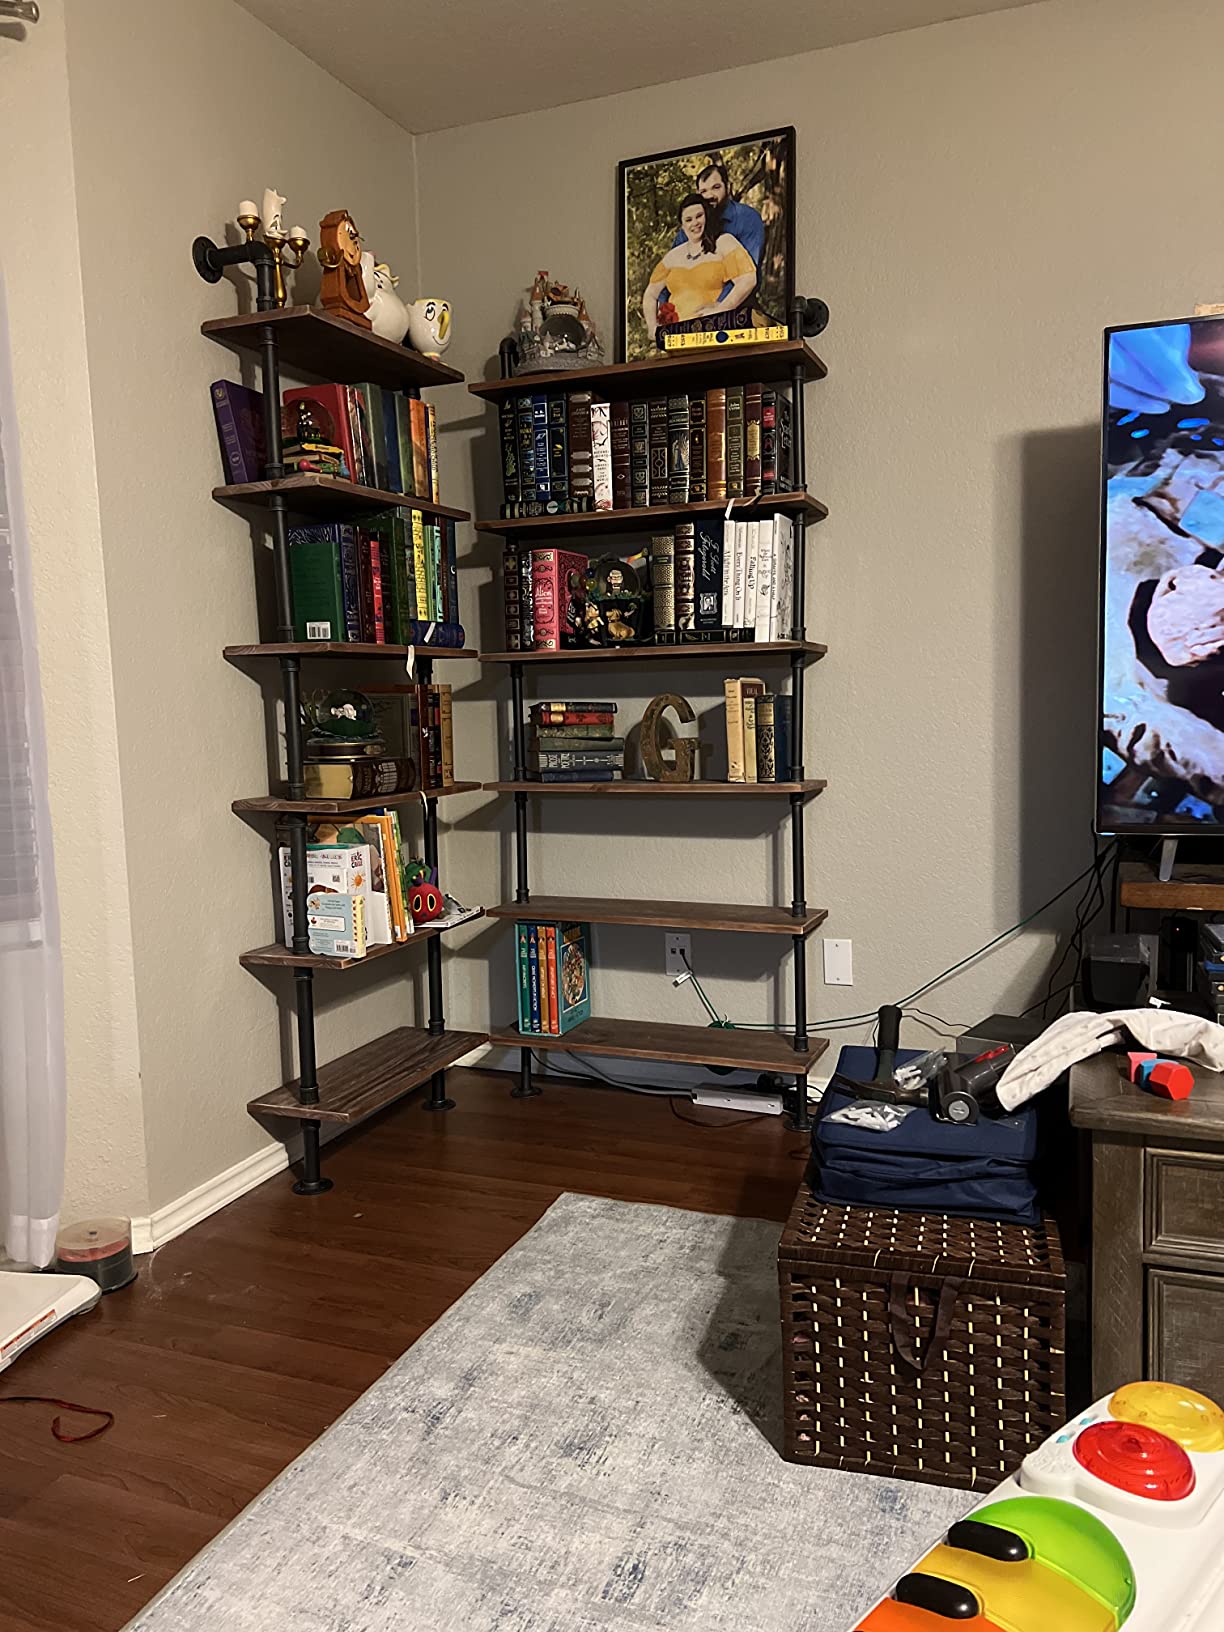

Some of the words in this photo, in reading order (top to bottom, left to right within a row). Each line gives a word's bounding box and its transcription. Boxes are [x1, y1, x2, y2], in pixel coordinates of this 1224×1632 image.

[697, 531, 711, 581] Fitzgerald
[710, 552, 720, 575] Scott
[735, 552, 743, 568] Every
[748, 556, 756, 580] Falling
[535, 586, 552, 597] Alice
[735, 586, 741, 595] On
[640, 693, 699, 782] G
[548, 754, 558, 768] PROSE
